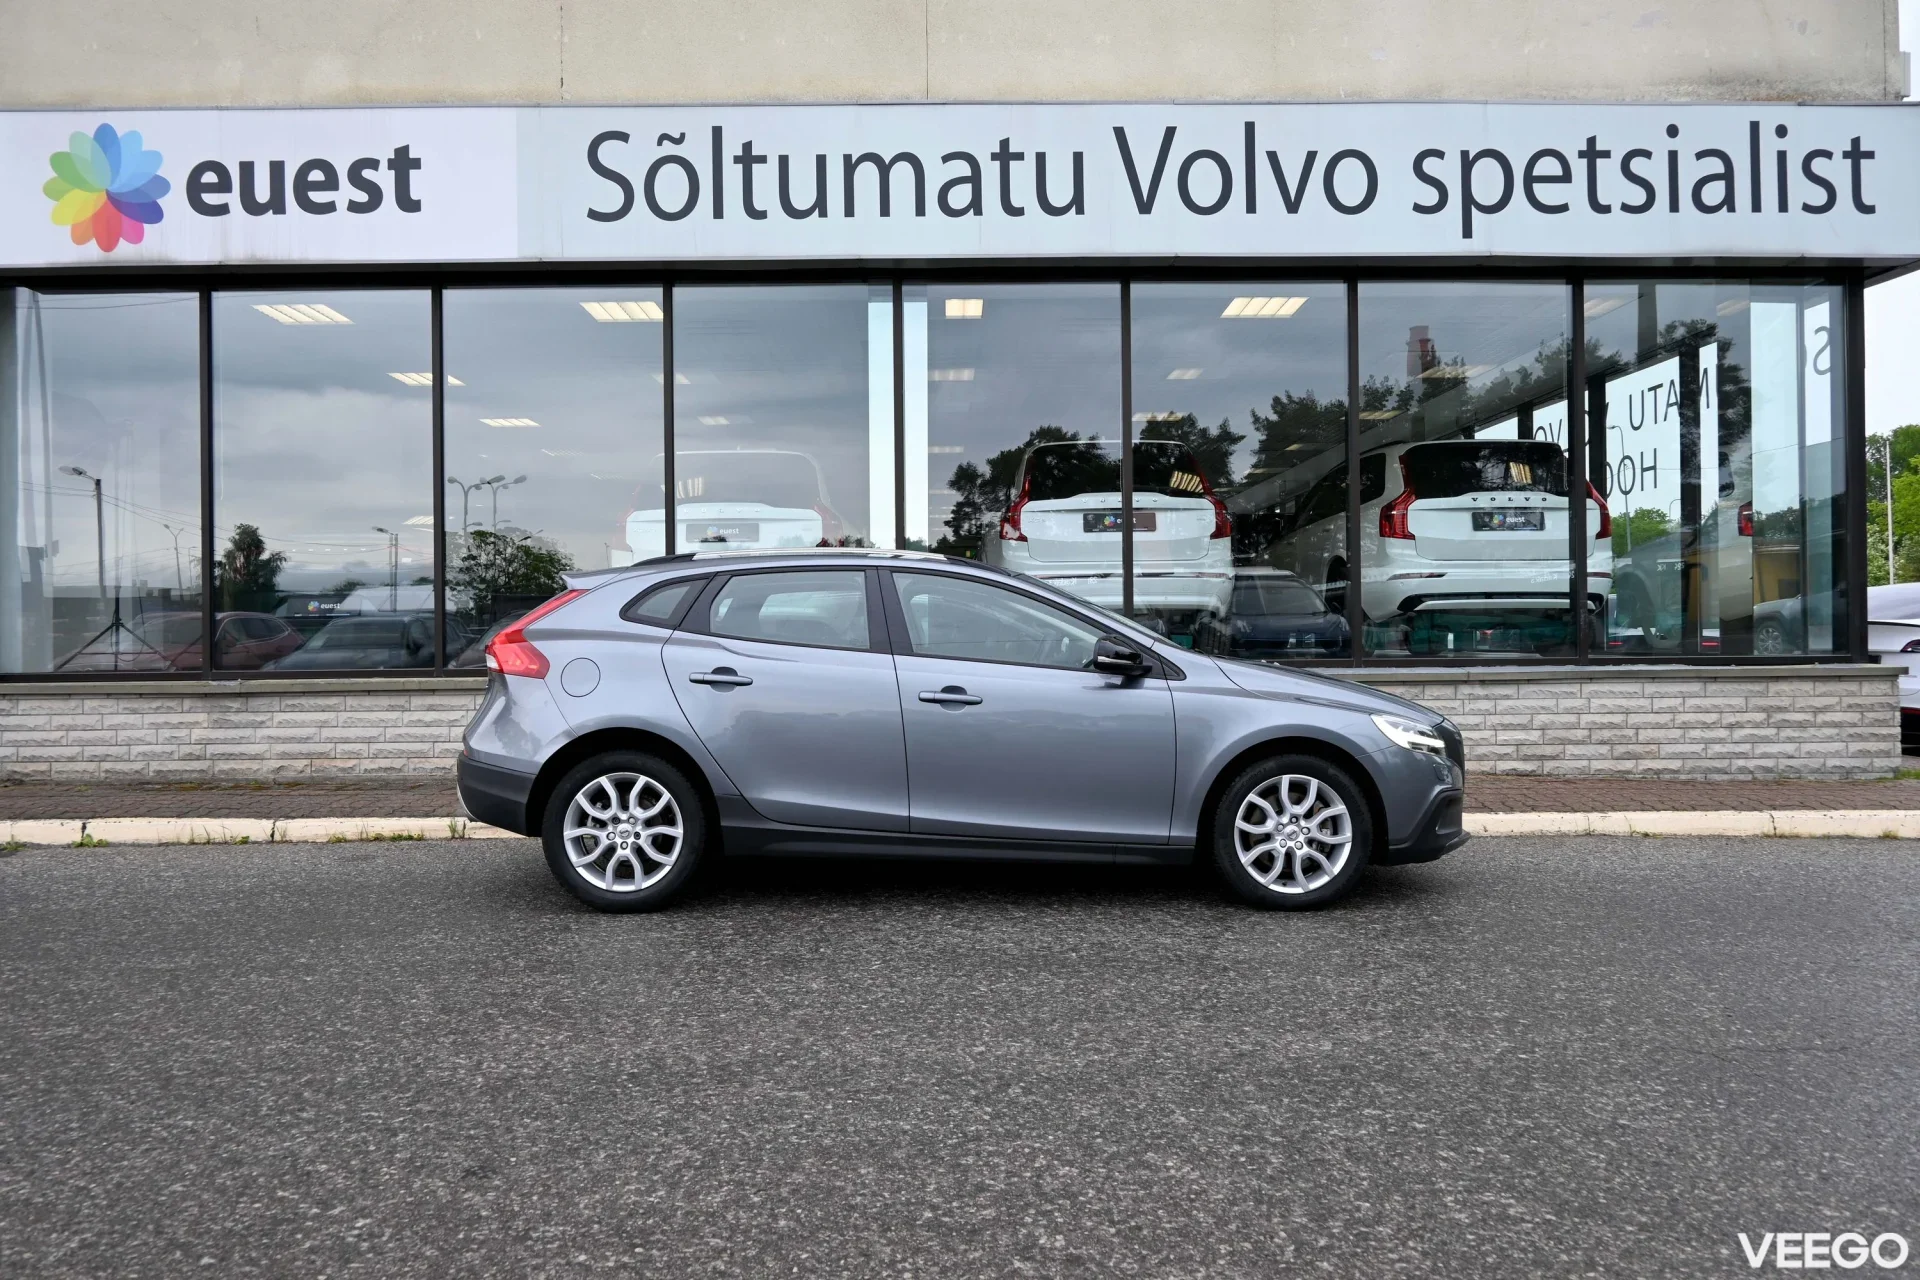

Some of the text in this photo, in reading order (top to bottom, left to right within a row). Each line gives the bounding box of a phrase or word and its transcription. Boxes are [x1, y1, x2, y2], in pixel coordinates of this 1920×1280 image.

[185, 144, 422, 217] euest
[586, 120, 1876, 239] Sõltumatu Volvo spetsialist
[1505, 515, 1526, 523] euest
[719, 527, 740, 535] euest
[320, 602, 341, 610] euest
